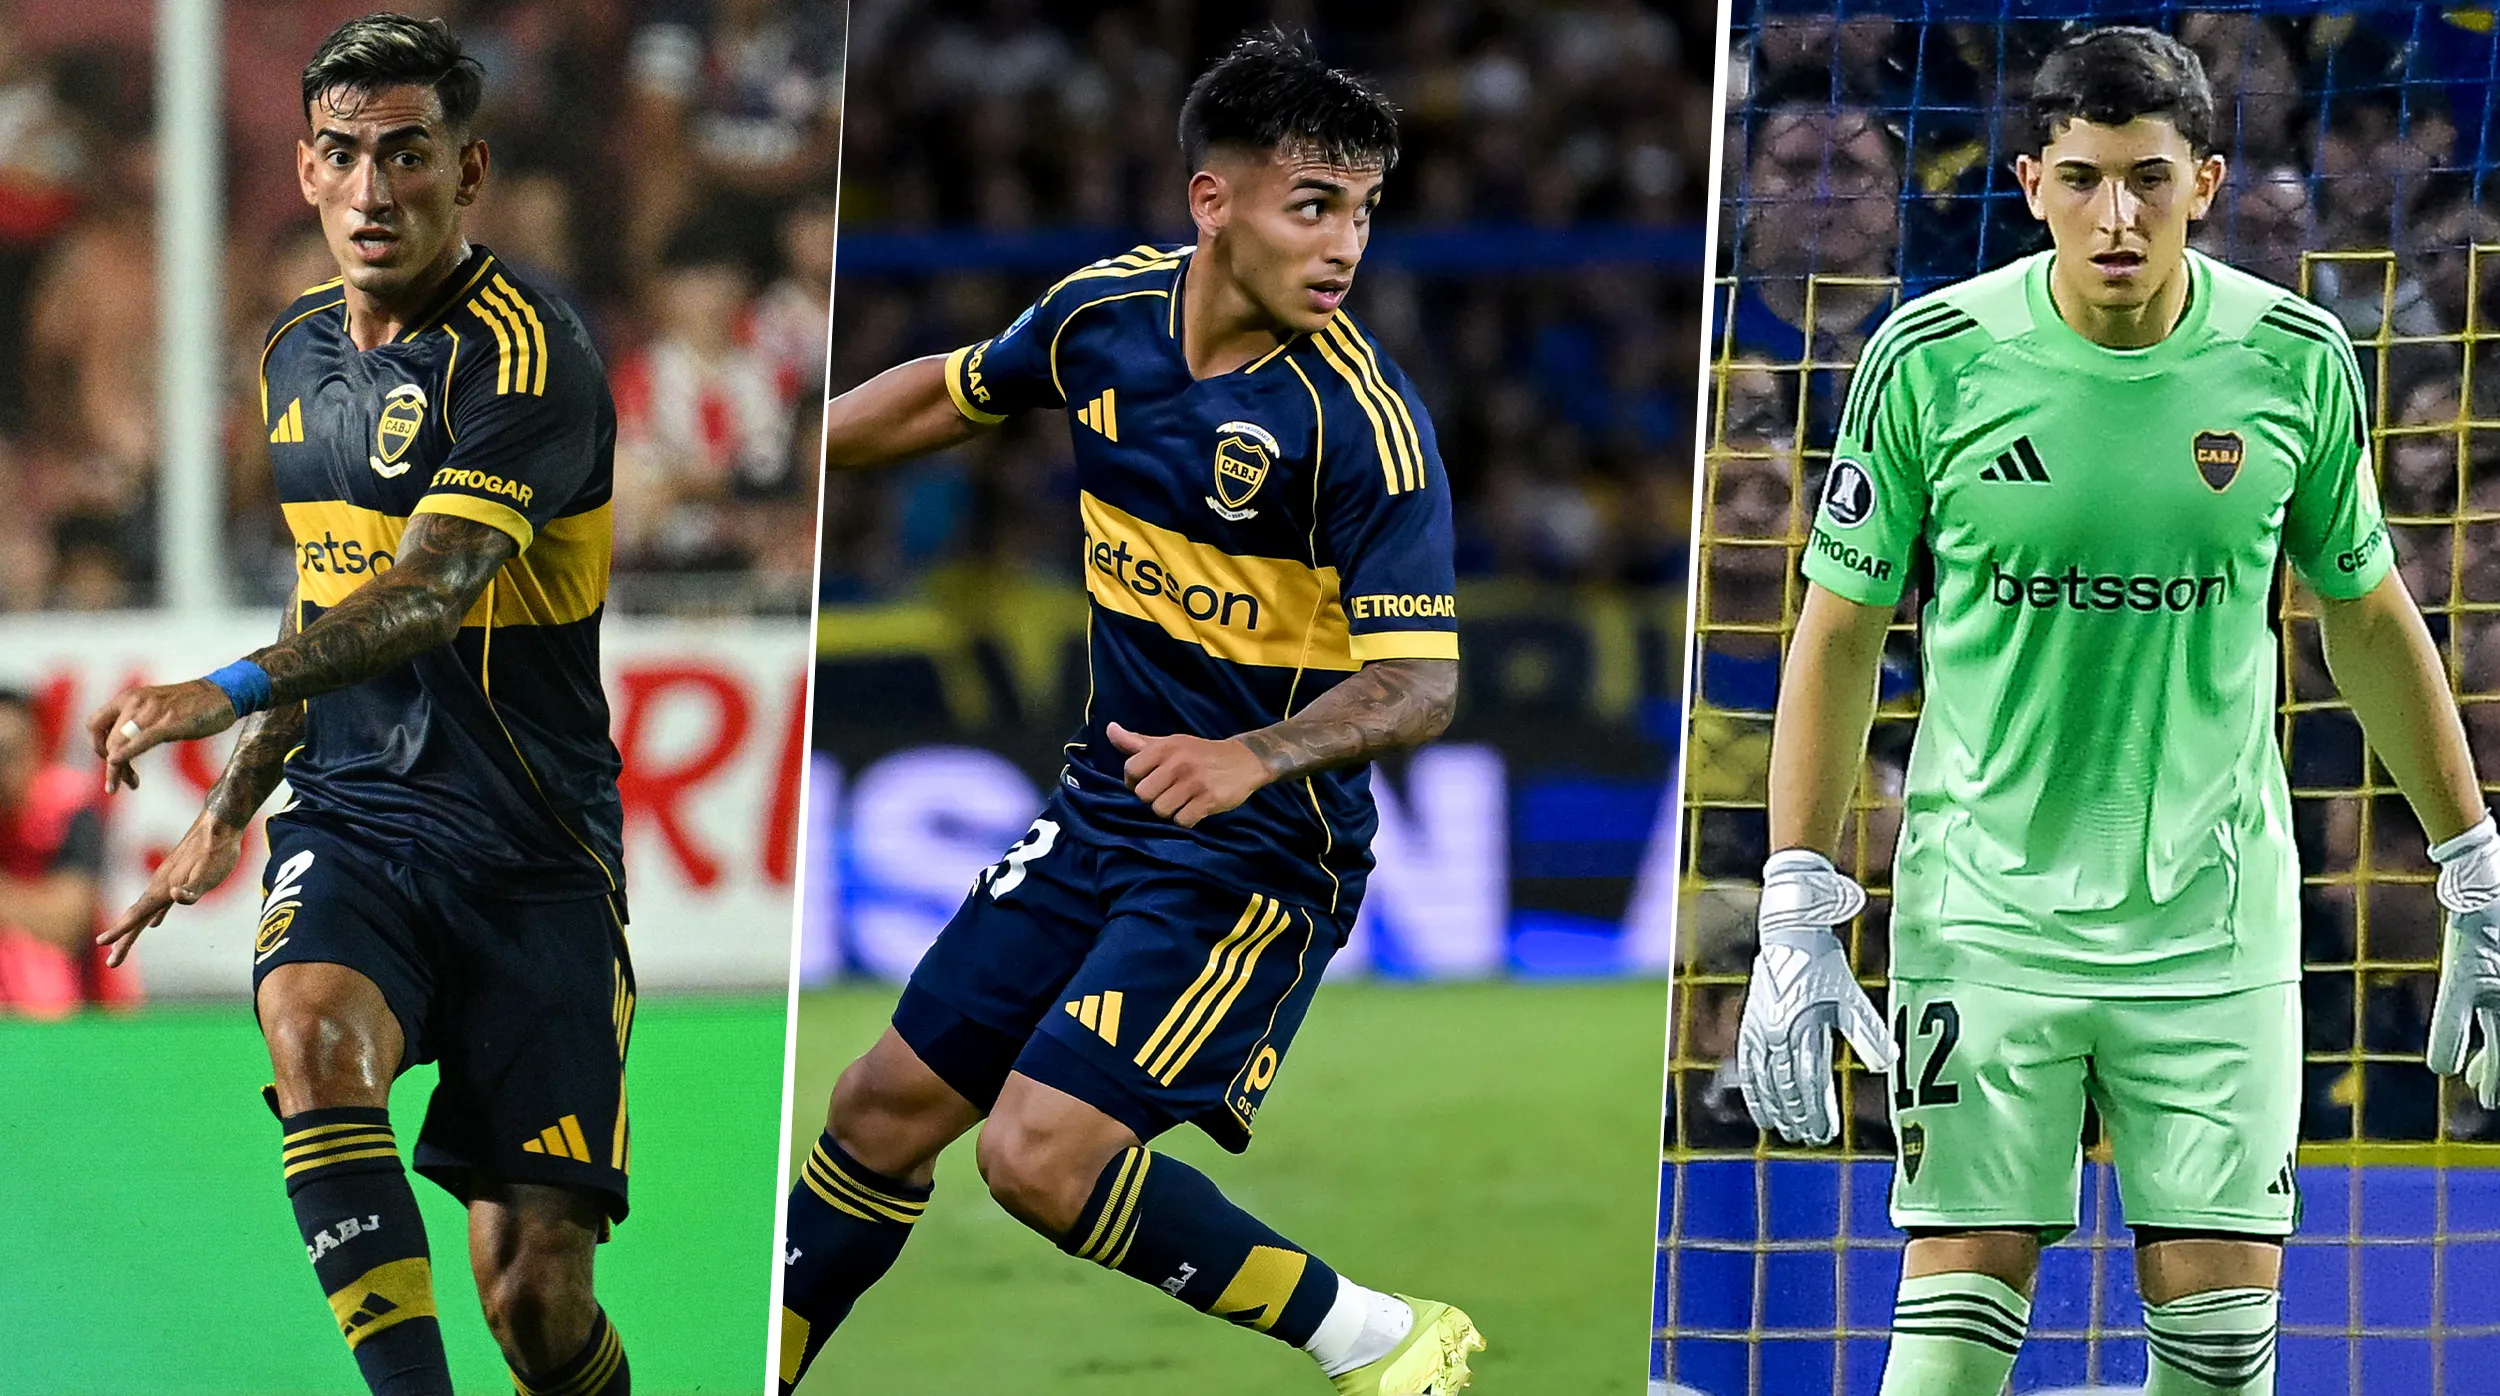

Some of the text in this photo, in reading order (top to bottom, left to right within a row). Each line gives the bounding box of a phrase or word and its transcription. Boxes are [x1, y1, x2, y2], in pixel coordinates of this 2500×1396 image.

[385, 420, 412, 434] CABJ
[2198, 449, 2239, 464] CABJ
[1222, 459, 1258, 481] CABJ
[1993, 561, 2226, 612] betsson
[1351, 594, 1456, 618] ETROGAR
[1895, 1001, 1959, 1111] 12
